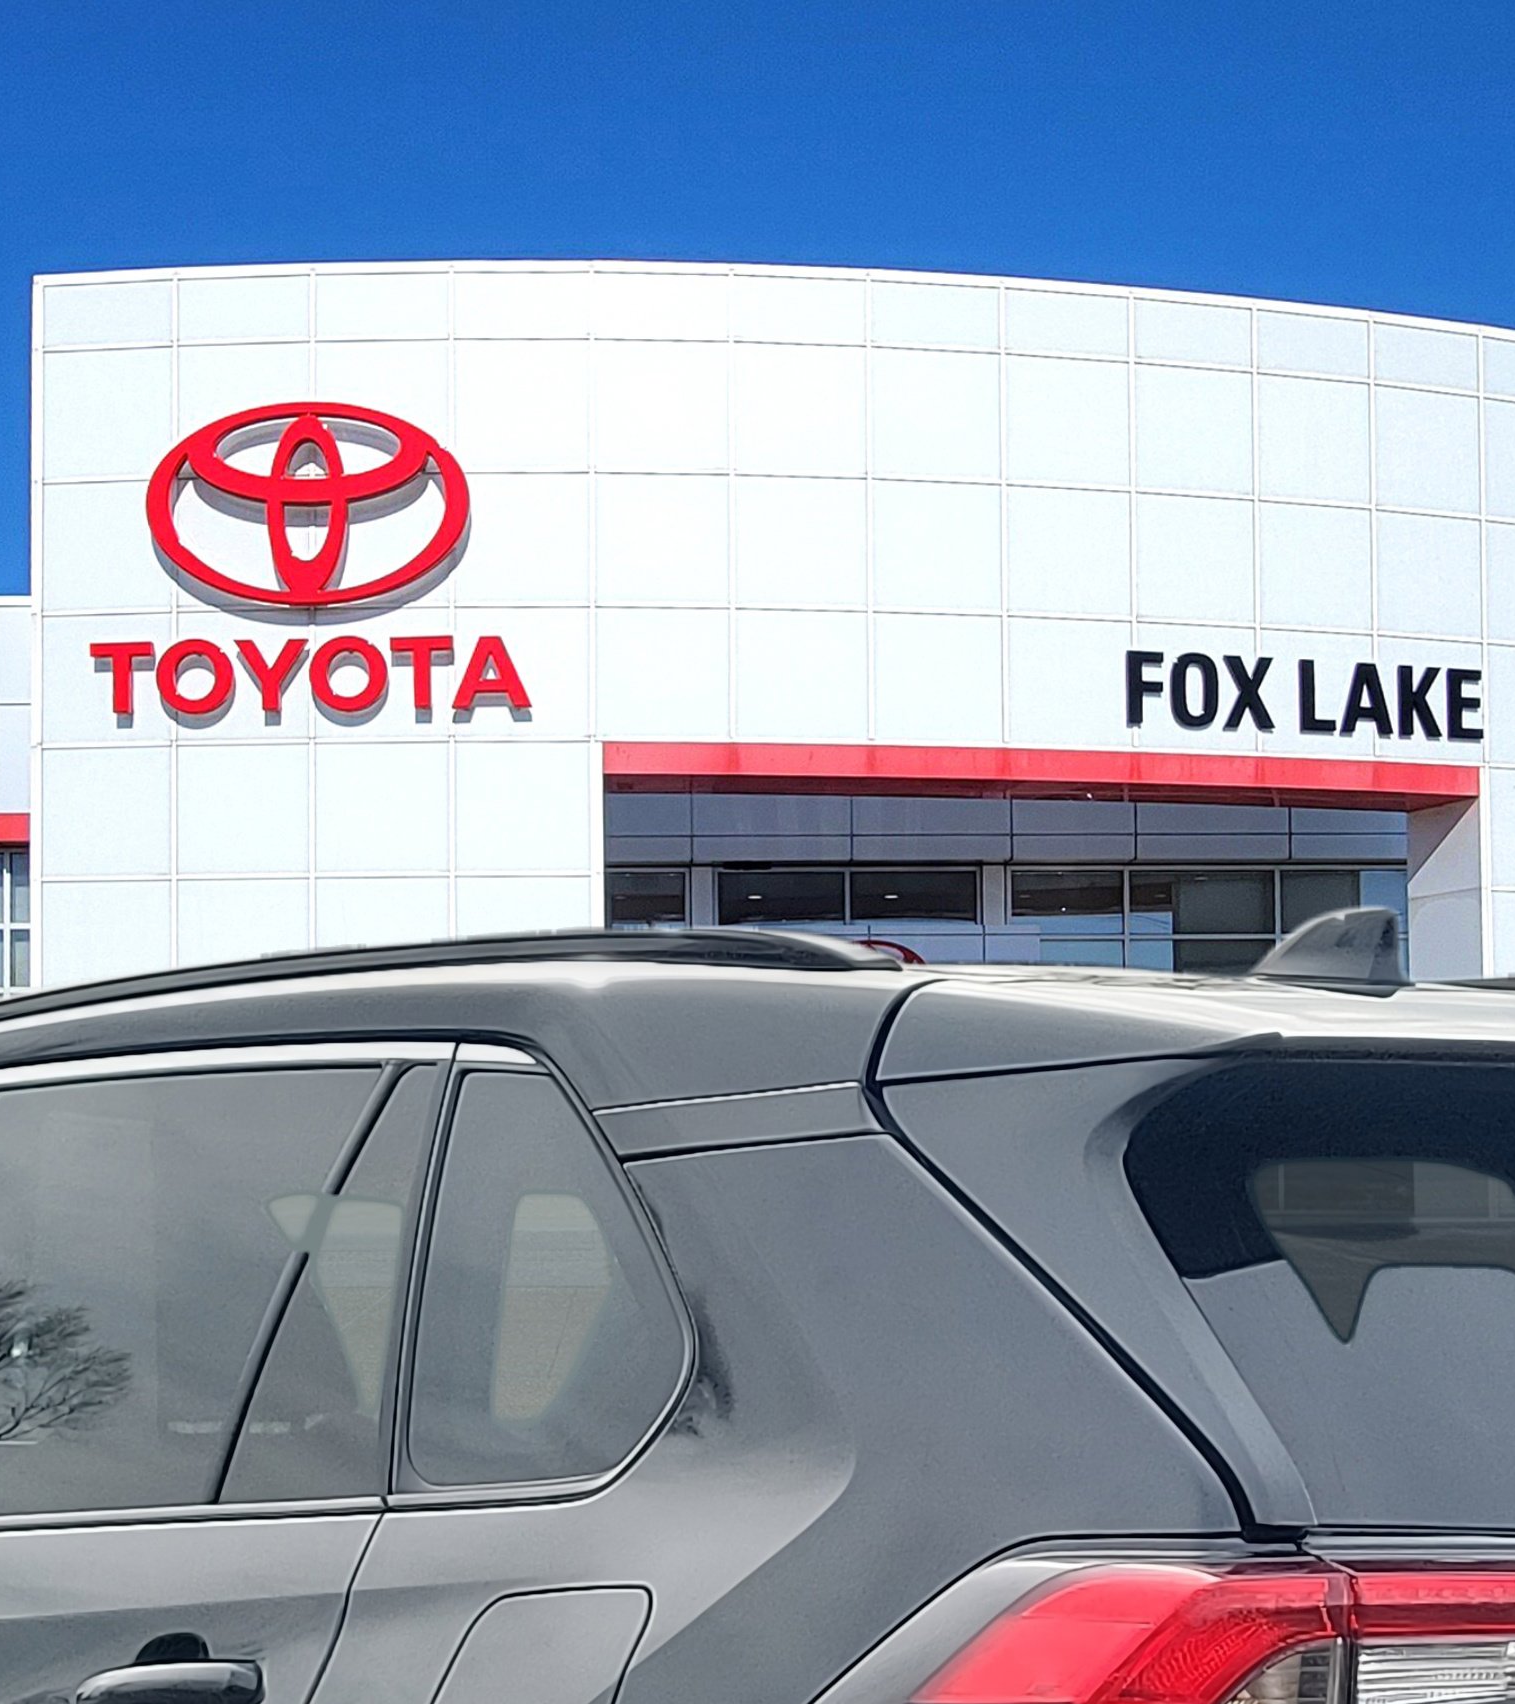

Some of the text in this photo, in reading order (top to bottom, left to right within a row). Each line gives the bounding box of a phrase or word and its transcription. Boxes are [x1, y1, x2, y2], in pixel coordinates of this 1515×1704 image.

[89, 634, 533, 717] TOYOTA
[1125, 650, 1485, 740] FOX LAKE
